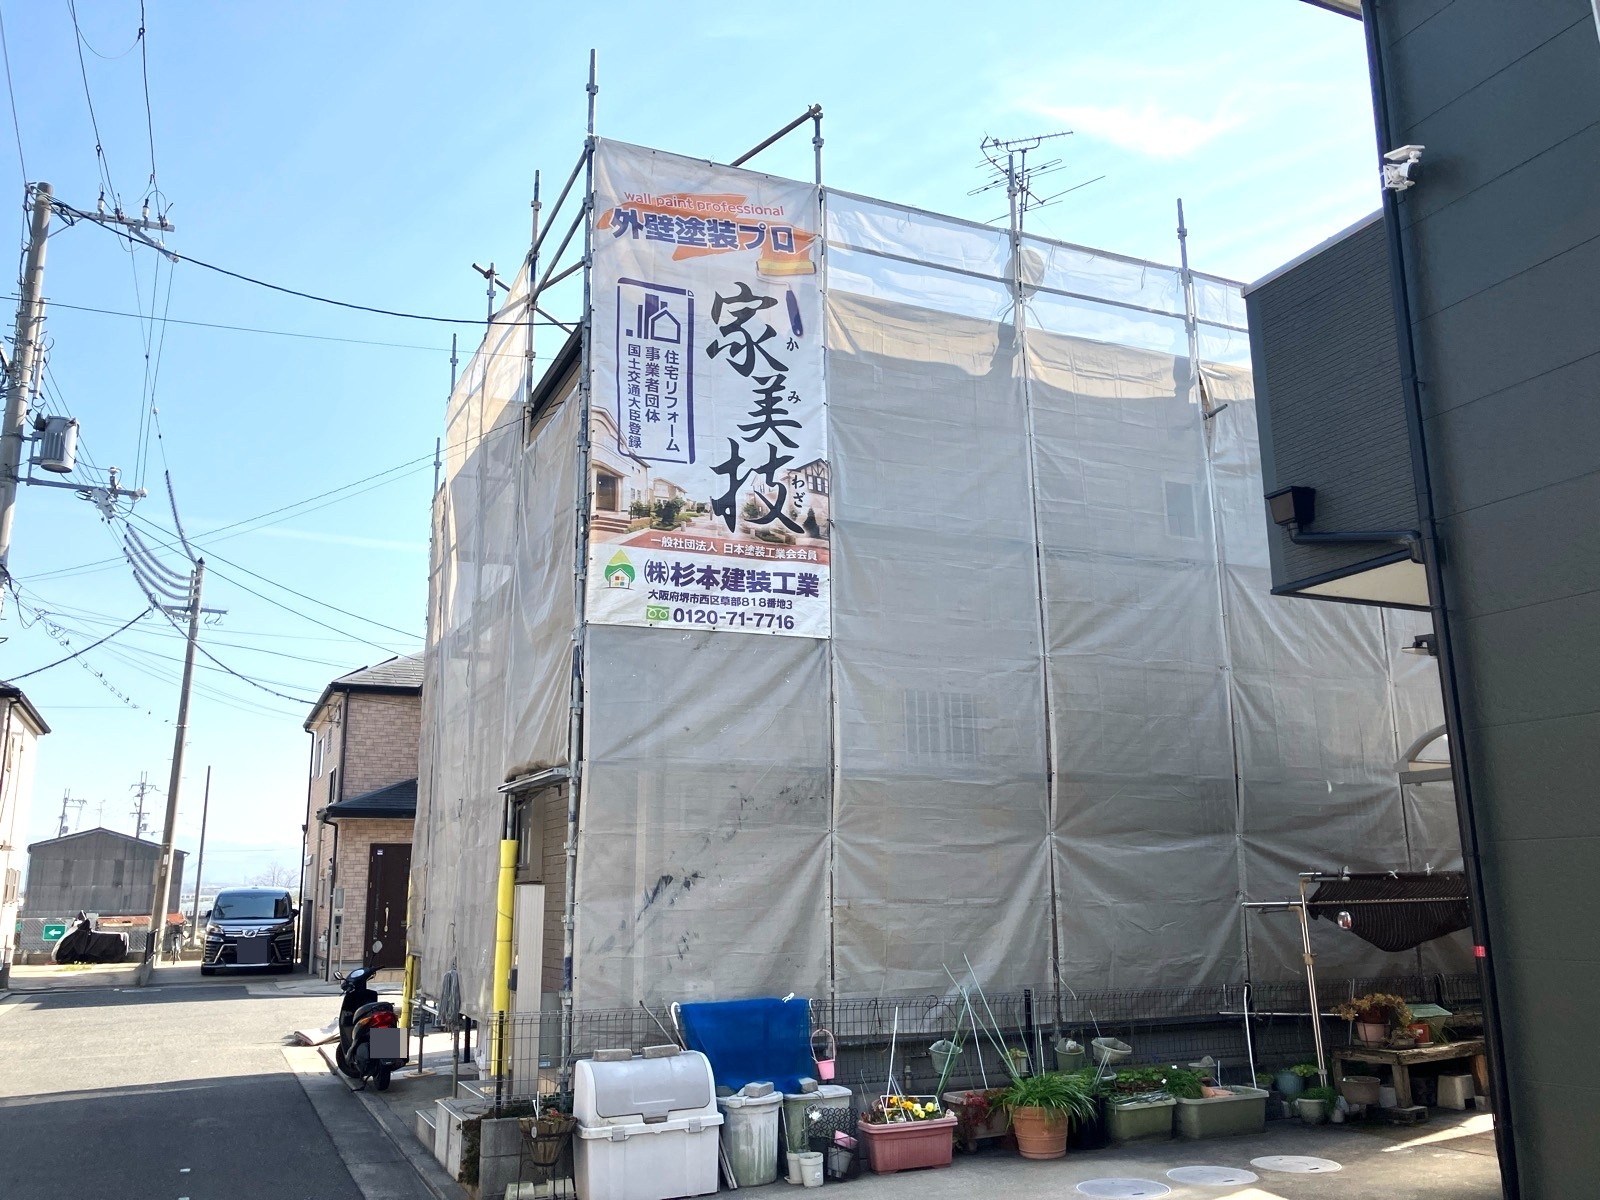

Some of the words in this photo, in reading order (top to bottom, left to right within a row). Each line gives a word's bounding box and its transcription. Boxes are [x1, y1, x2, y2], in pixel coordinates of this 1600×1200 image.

[623, 191, 653, 205] wall
[656, 195, 694, 210] paint
[698, 199, 784, 216] professional
[609, 208, 796, 253] 外壁塗装プロ
[786, 337, 800, 352] か
[627, 343, 642, 449] 国土交通大臣登録
[644, 346, 661, 424] 事業者団体
[787, 390, 802, 404] み
[663, 349, 681, 452] 住宅リフォーム
[706, 281, 805, 533] 家美技
[791, 474, 806, 509] わざ
[650, 537, 718, 553] 一般社団法人
[723, 543, 818, 561] 日本塗装工業会会員
[647, 589, 793, 610] 大阪府堺市西区草部818番地3
[672, 607, 795, 630] 0120-71-7716
